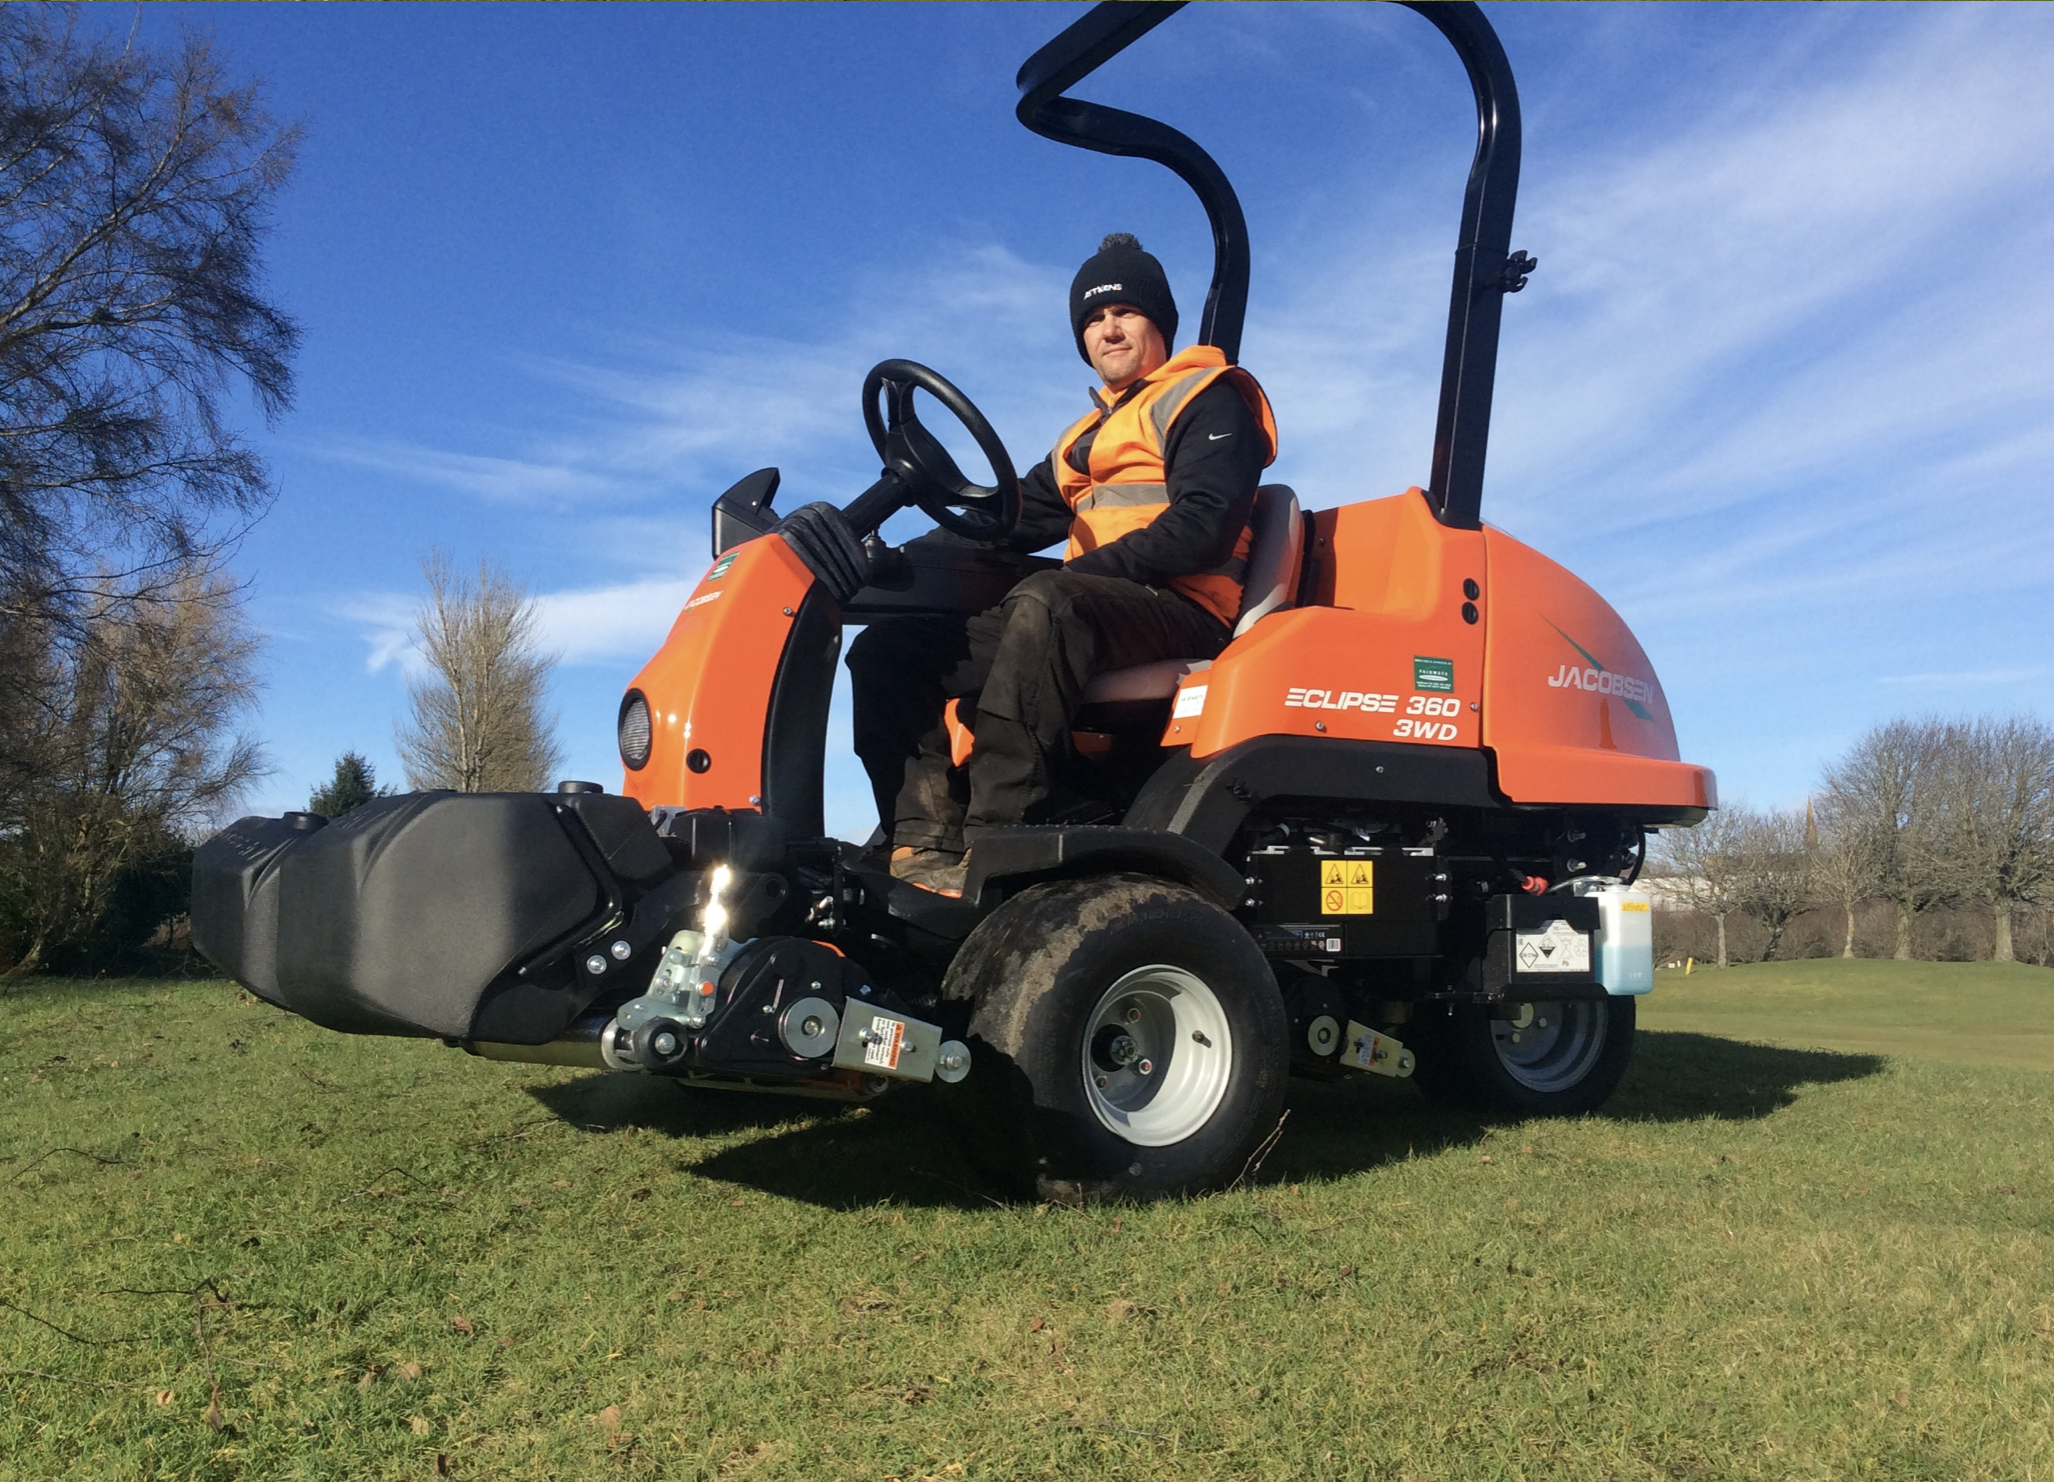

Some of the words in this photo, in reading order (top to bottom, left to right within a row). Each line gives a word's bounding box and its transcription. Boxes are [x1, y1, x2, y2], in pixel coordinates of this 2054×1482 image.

[1548, 665, 1654, 704] JACOBSEN
[1285, 687, 1399, 713] ECLIPSE
[1406, 696, 1461, 717] 360
[1393, 719, 1458, 741] 3WD
[889, 1032, 900, 1066] WARNING
